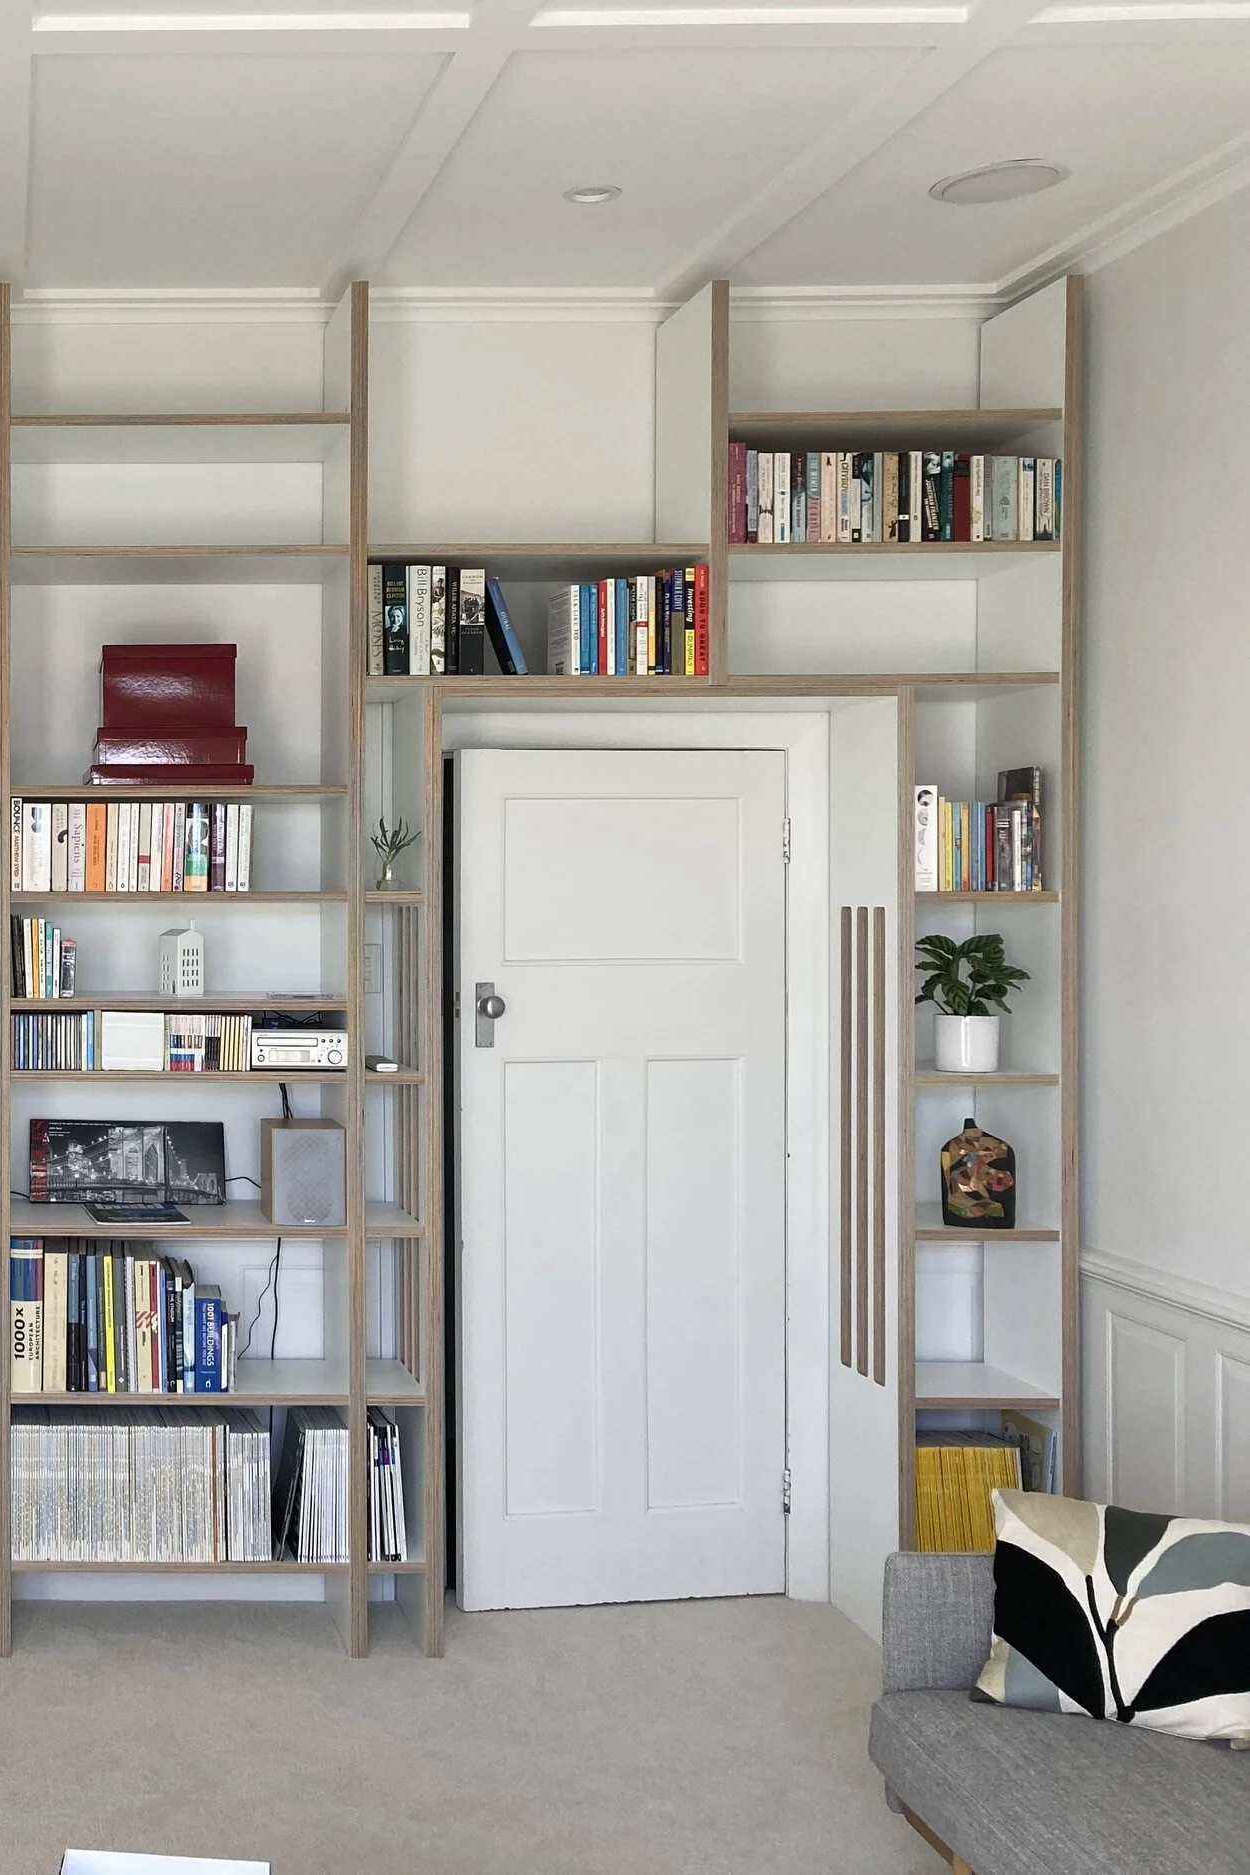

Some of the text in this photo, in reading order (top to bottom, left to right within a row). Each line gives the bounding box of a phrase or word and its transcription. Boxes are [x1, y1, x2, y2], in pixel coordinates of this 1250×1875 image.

[416, 569, 428, 585] Bill
[674, 570, 682, 589] STEPHEN
[416, 588, 428, 626] Bryson
[674, 595, 682, 610] COVEY
[372, 611, 383, 657] MOSES
[699, 619, 705, 629] TO
[13, 800, 21, 834] BOUNCE
[72, 824, 83, 863] Sapiens
[14, 1308, 25, 1360] 1000x
